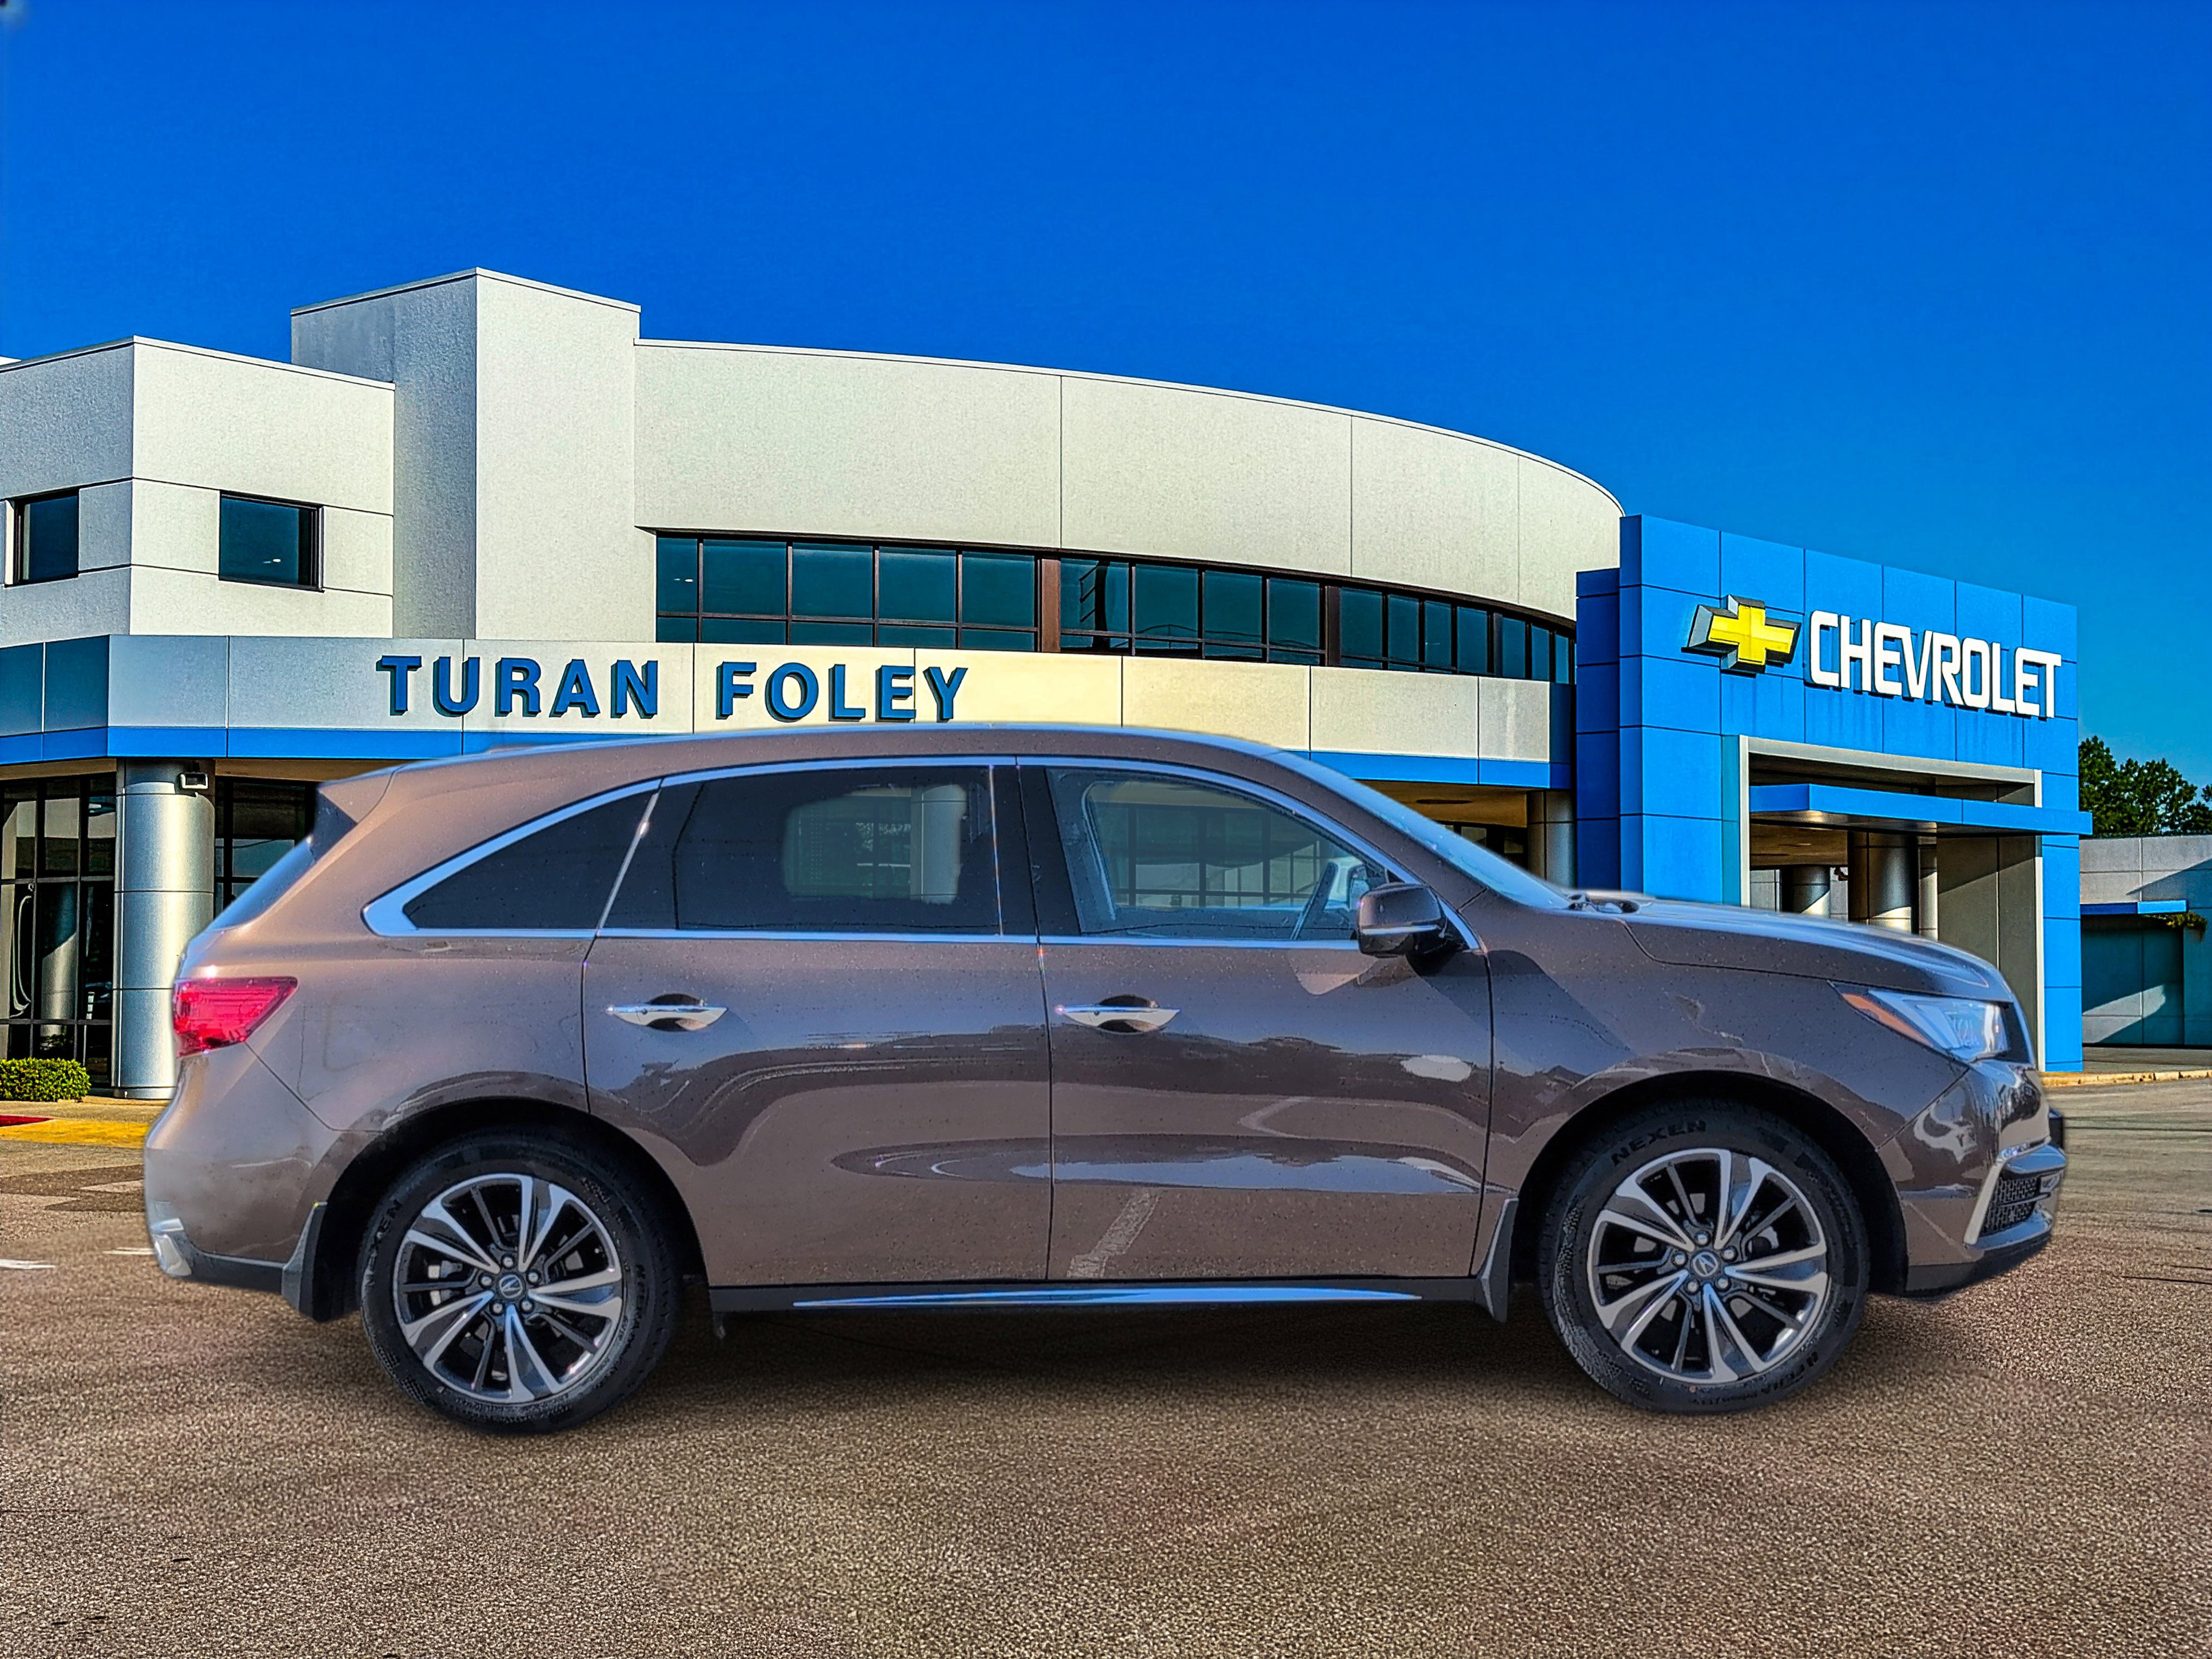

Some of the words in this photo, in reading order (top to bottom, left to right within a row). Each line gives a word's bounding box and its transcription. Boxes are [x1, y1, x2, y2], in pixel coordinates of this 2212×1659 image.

[376, 655, 658, 718] TURAN
[717, 661, 968, 722] FOLEY
[1810, 610, 2062, 718] CHEVROLET
[1611, 1119, 1707, 1167] NEXEN
